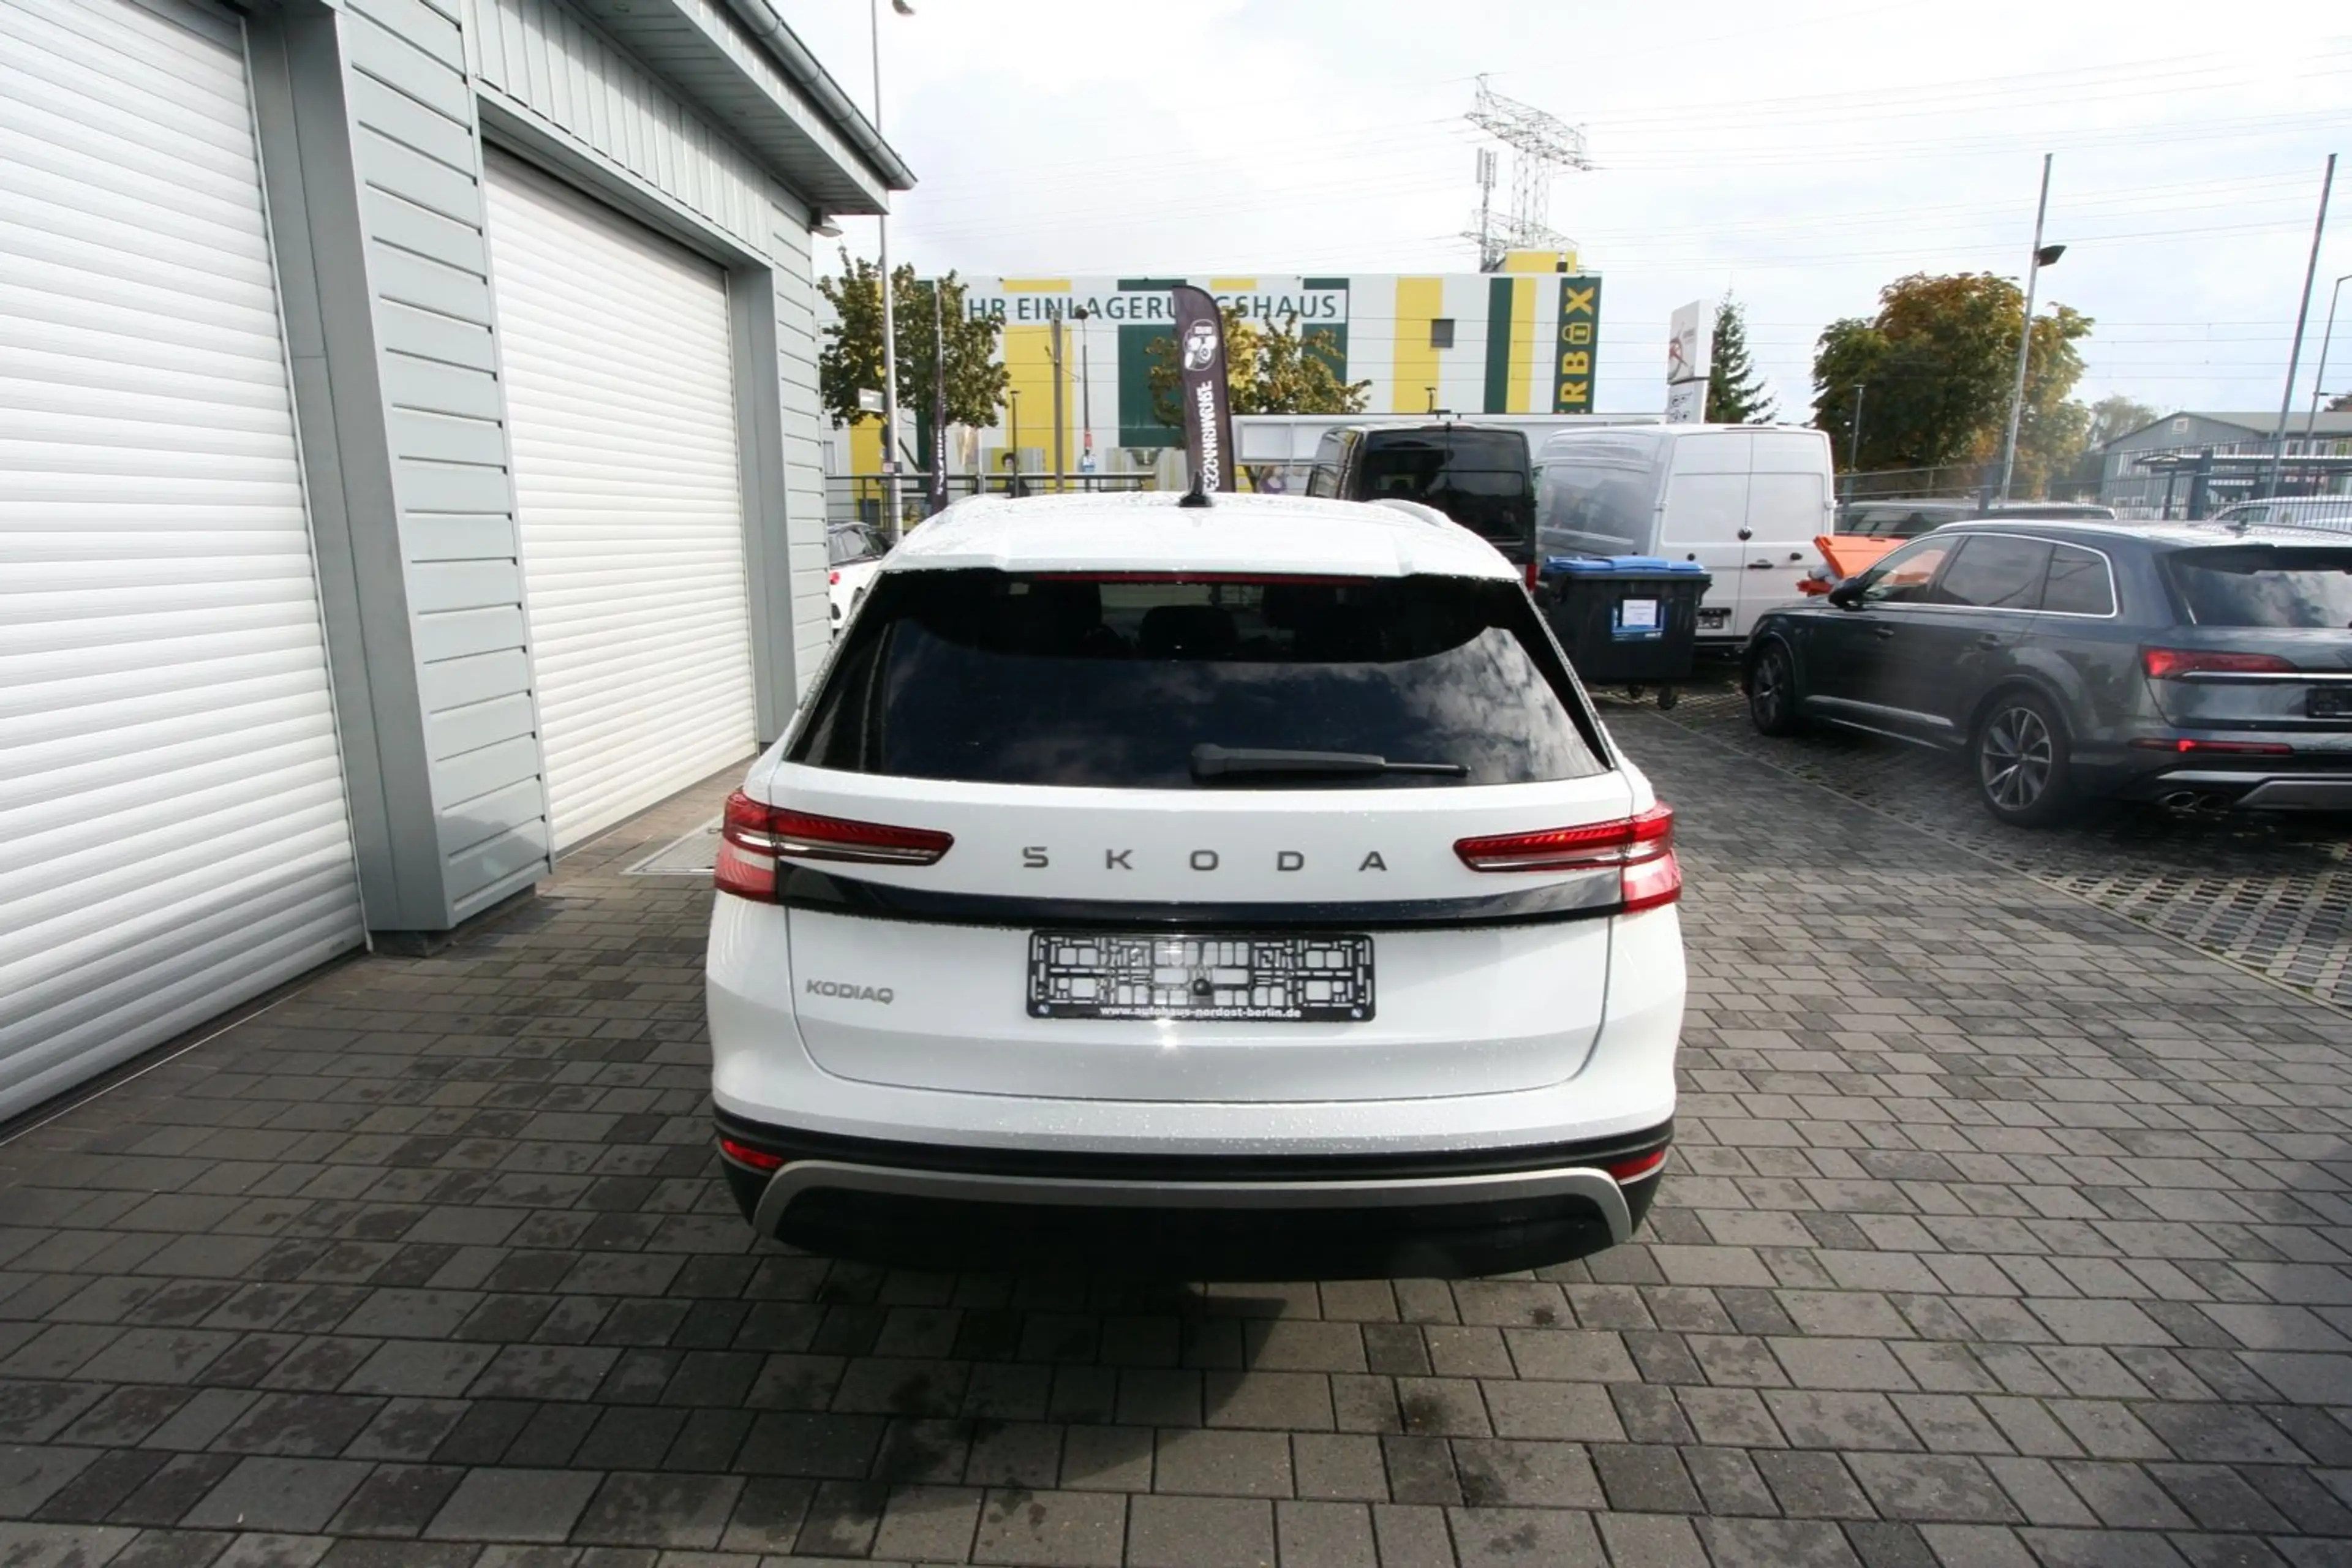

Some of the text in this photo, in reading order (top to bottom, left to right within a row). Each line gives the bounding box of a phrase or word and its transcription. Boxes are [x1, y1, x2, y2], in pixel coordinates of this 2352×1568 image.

[1022, 846, 1388, 872] SKODA
[806, 979, 894, 1005] KODIAQ
[1100, 1005, 1302, 1018] www.autohaus-nordost-berlin.de
